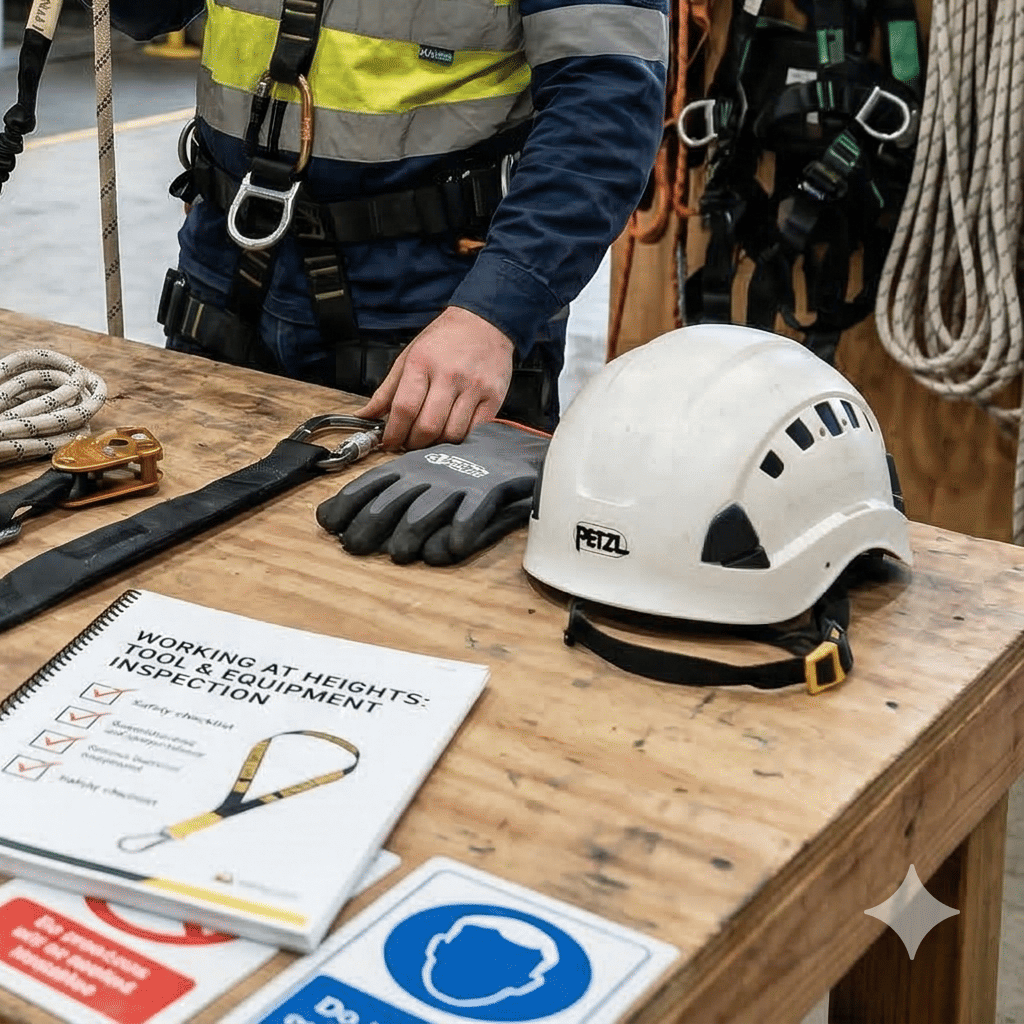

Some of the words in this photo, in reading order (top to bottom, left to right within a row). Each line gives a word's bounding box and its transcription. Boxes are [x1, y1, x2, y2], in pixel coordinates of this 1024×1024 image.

[576, 525, 630, 556] PETZL
[108, 656, 271, 706] INSPECTION
[124, 642, 187, 670] TOOL
[195, 662, 214, 676] &
[222, 668, 384, 714] EQUIPMENT
[136, 630, 257, 669] WORKING
[260, 663, 299, 678] AT
[302, 671, 431, 708] HEIGHTS:
